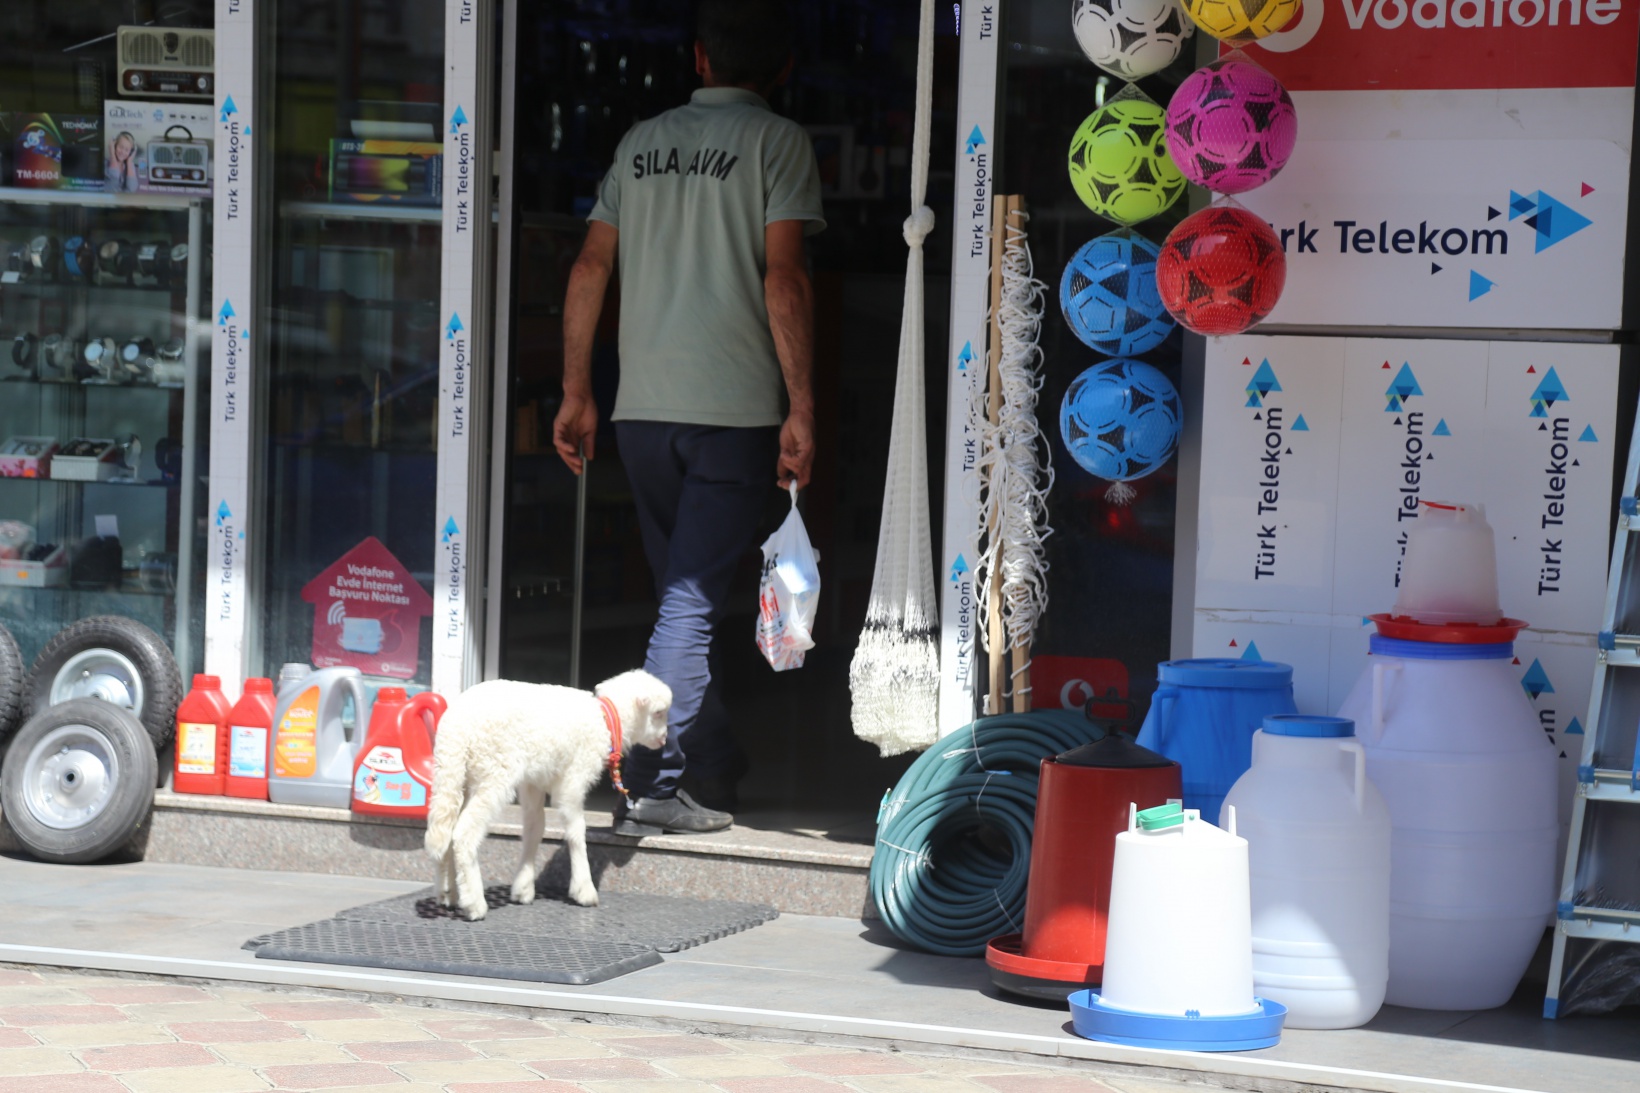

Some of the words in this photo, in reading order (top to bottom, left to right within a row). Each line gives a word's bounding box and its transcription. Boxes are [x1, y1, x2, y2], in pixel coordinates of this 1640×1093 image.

[460, 0, 471, 24] Tür
[979, 5, 993, 40] Türk
[227, 121, 239, 184] Telekom
[457, 132, 470, 196] Telekom
[632, 147, 681, 180] SILA
[685, 147, 740, 182] AVM
[227, 188, 239, 221] Türk
[972, 153, 987, 220] Telekom
[456, 201, 468, 233] Türk
[971, 224, 984, 258] Türk
[1268, 219, 1319, 253] rk
[1333, 219, 1509, 256] Telekom
[225, 324, 237, 386] Telekom
[453, 339, 466, 401] Telekom
[224, 391, 236, 422] Türk
[452, 406, 464, 438] Türk
[963, 439, 976, 472] Türk
[1257, 407, 1283, 516] Telekom
[1397, 411, 1424, 522] Telekom
[1541, 416, 1570, 530] Telekom
[221, 524, 233, 585] Telekom
[1254, 524, 1277, 580] Türk
[1537, 538, 1563, 597] Türk
[336, 575, 361, 588] Evde
[347, 563, 395, 579] Vodafone
[448, 541, 461, 603] Telekom
[220, 590, 232, 621] Türk
[447, 608, 459, 639] Türk
[957, 581, 971, 645] Telekom
[956, 650, 969, 683] Türk
